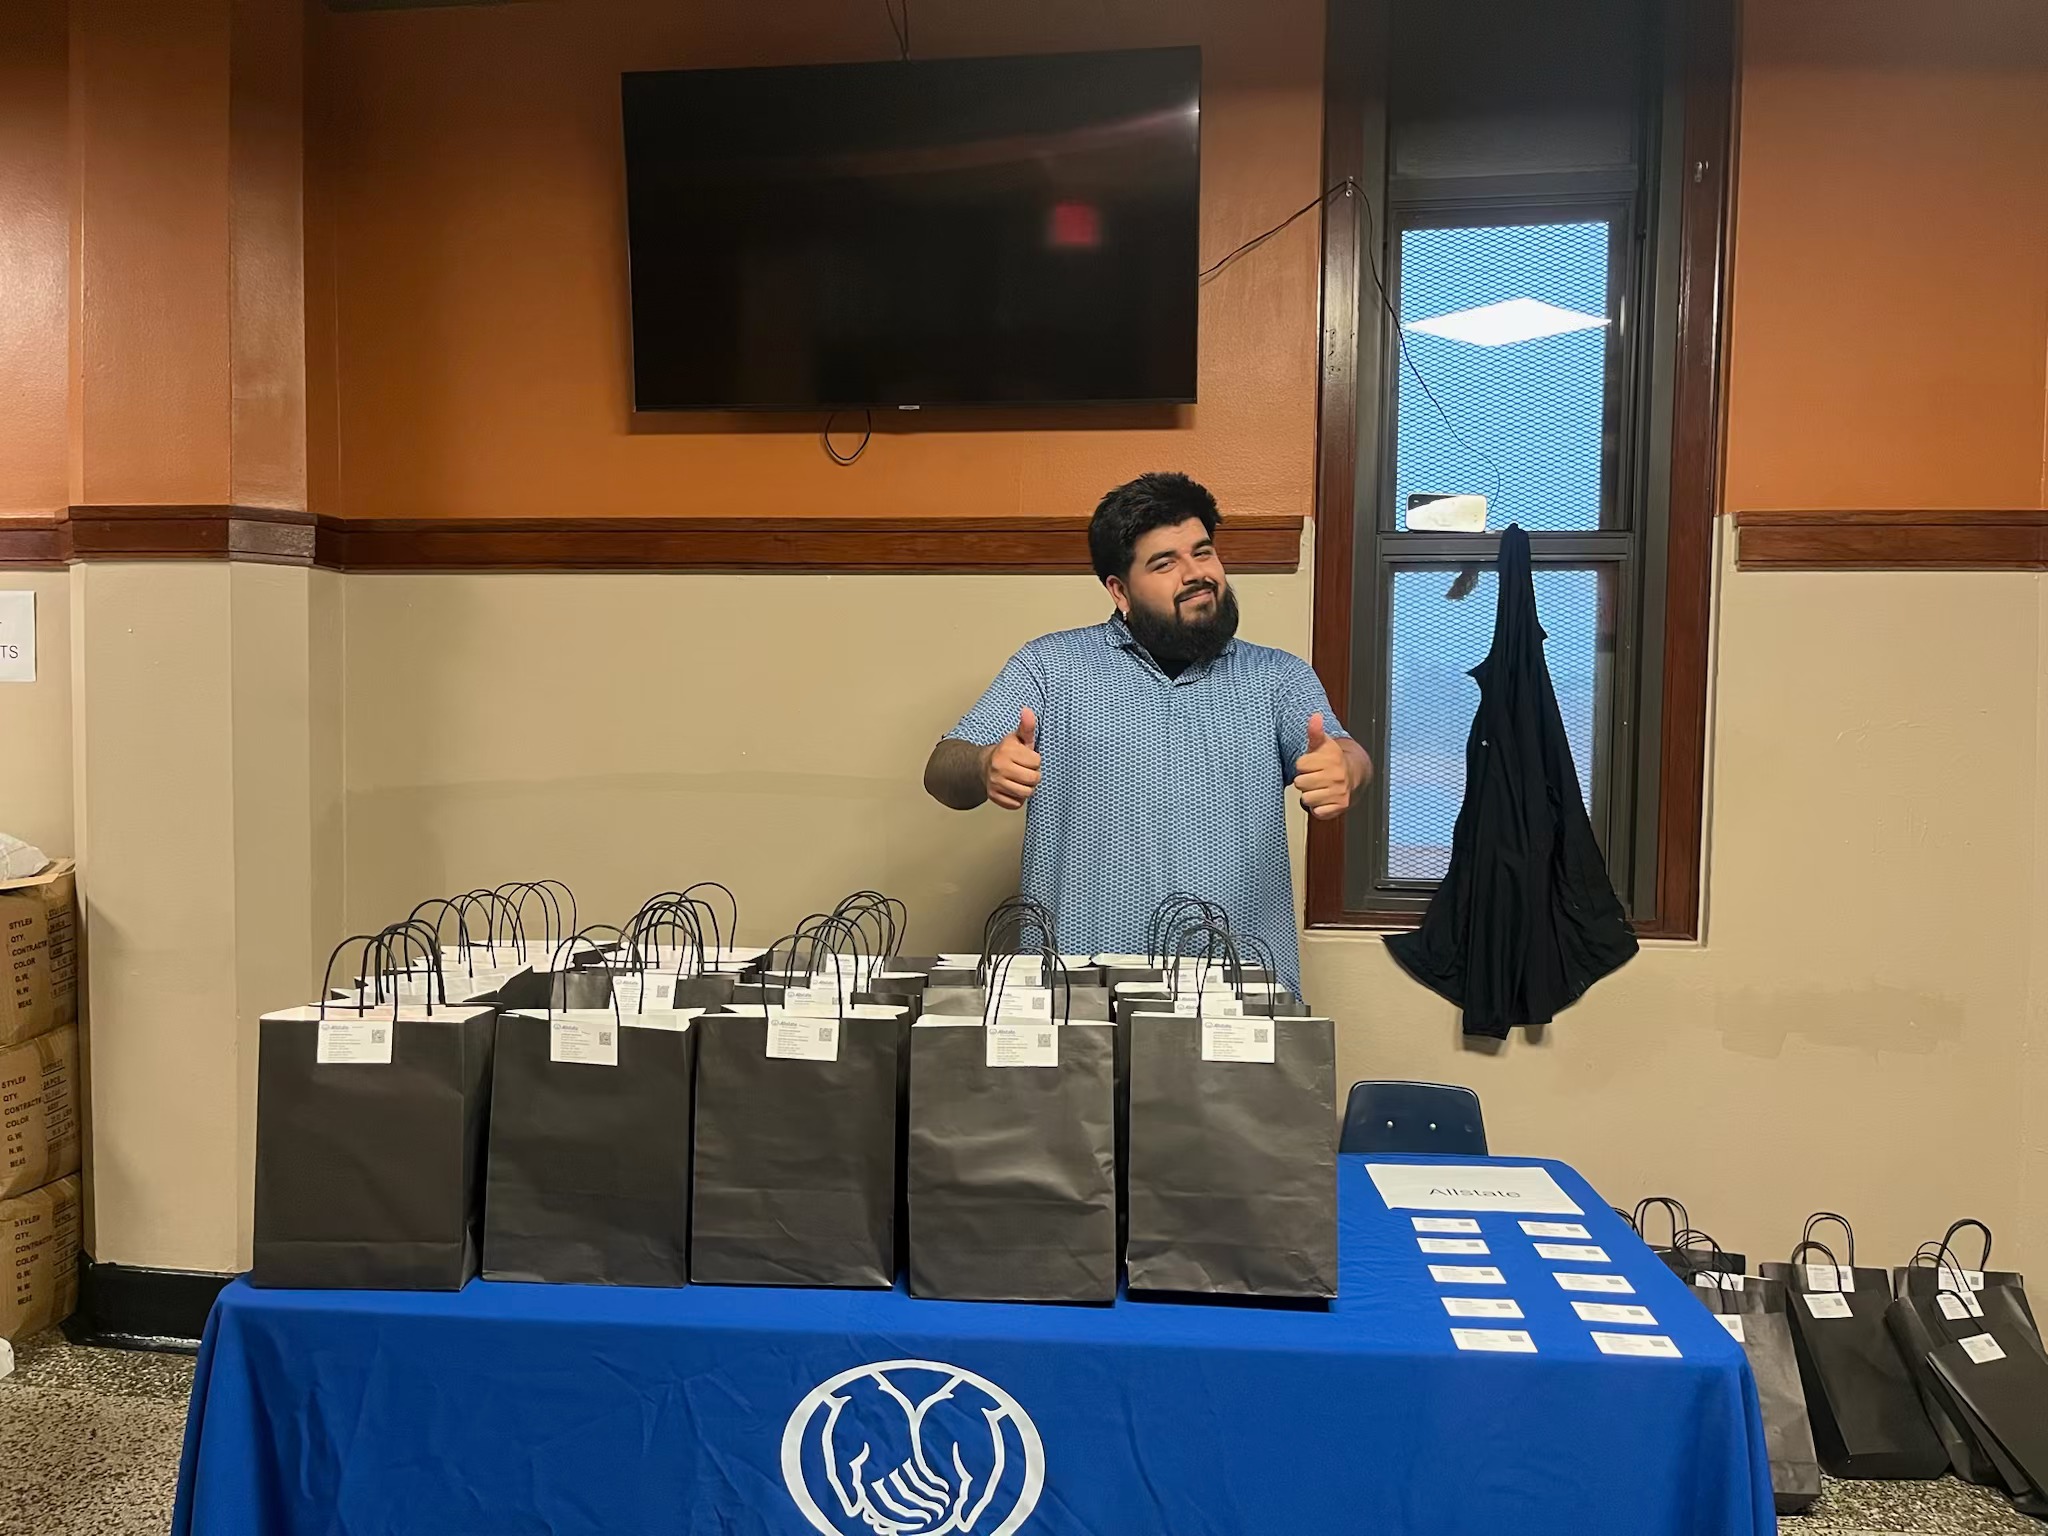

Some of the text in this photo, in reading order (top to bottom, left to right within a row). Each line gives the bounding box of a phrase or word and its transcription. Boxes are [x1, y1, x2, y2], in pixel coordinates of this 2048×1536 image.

[13, 957, 36, 970] COLOR
[5, 1115, 30, 1129] COLOR
[1430, 1188, 1521, 1198] Allstate
[15, 1253, 40, 1267] COLOR
